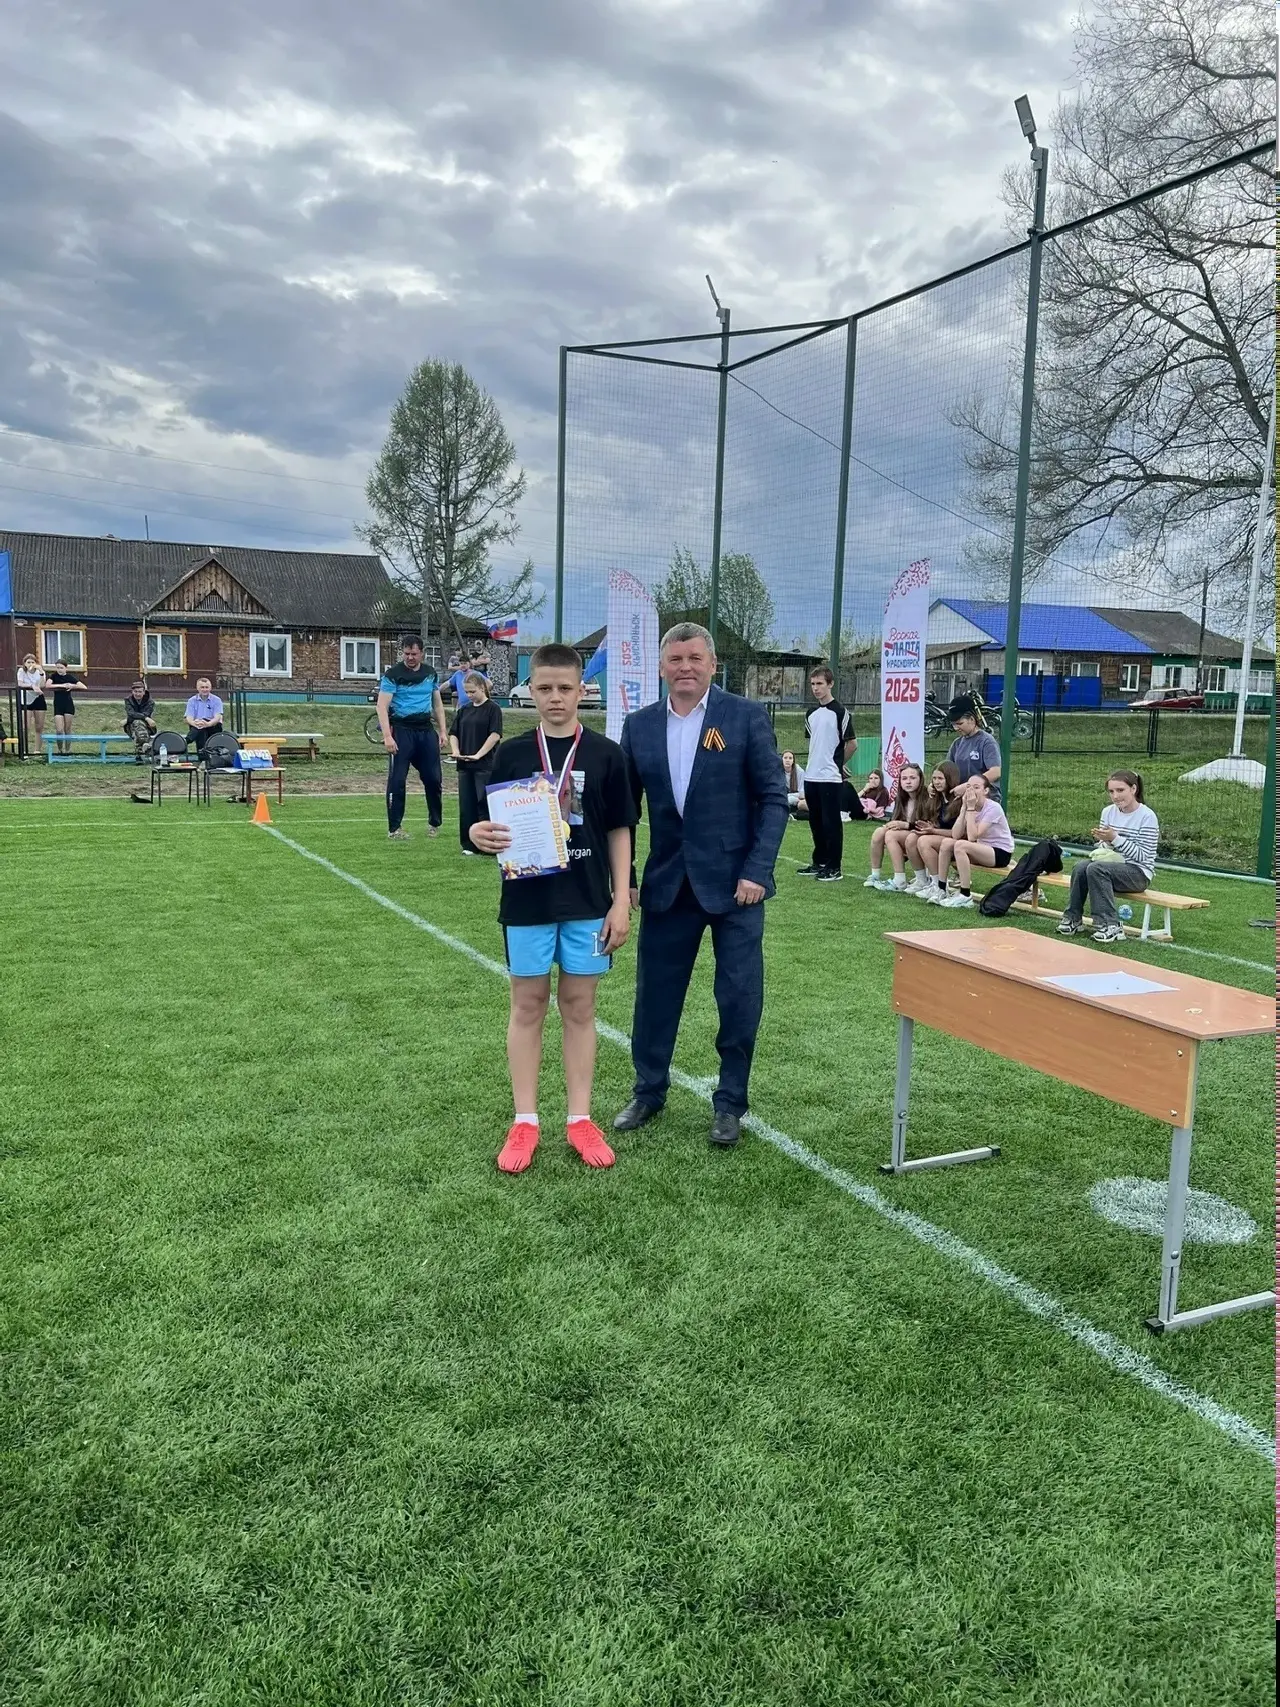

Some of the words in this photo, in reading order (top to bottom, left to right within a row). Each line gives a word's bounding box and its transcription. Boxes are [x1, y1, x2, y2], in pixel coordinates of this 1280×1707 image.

[891, 641, 920, 661] ЛАПТА
[886, 658, 920, 668] КРАСНОЯРСК
[885, 677, 920, 702] 2025
[504, 796, 543, 808] ГРАМОТА
[567, 848, 592, 859] organ
